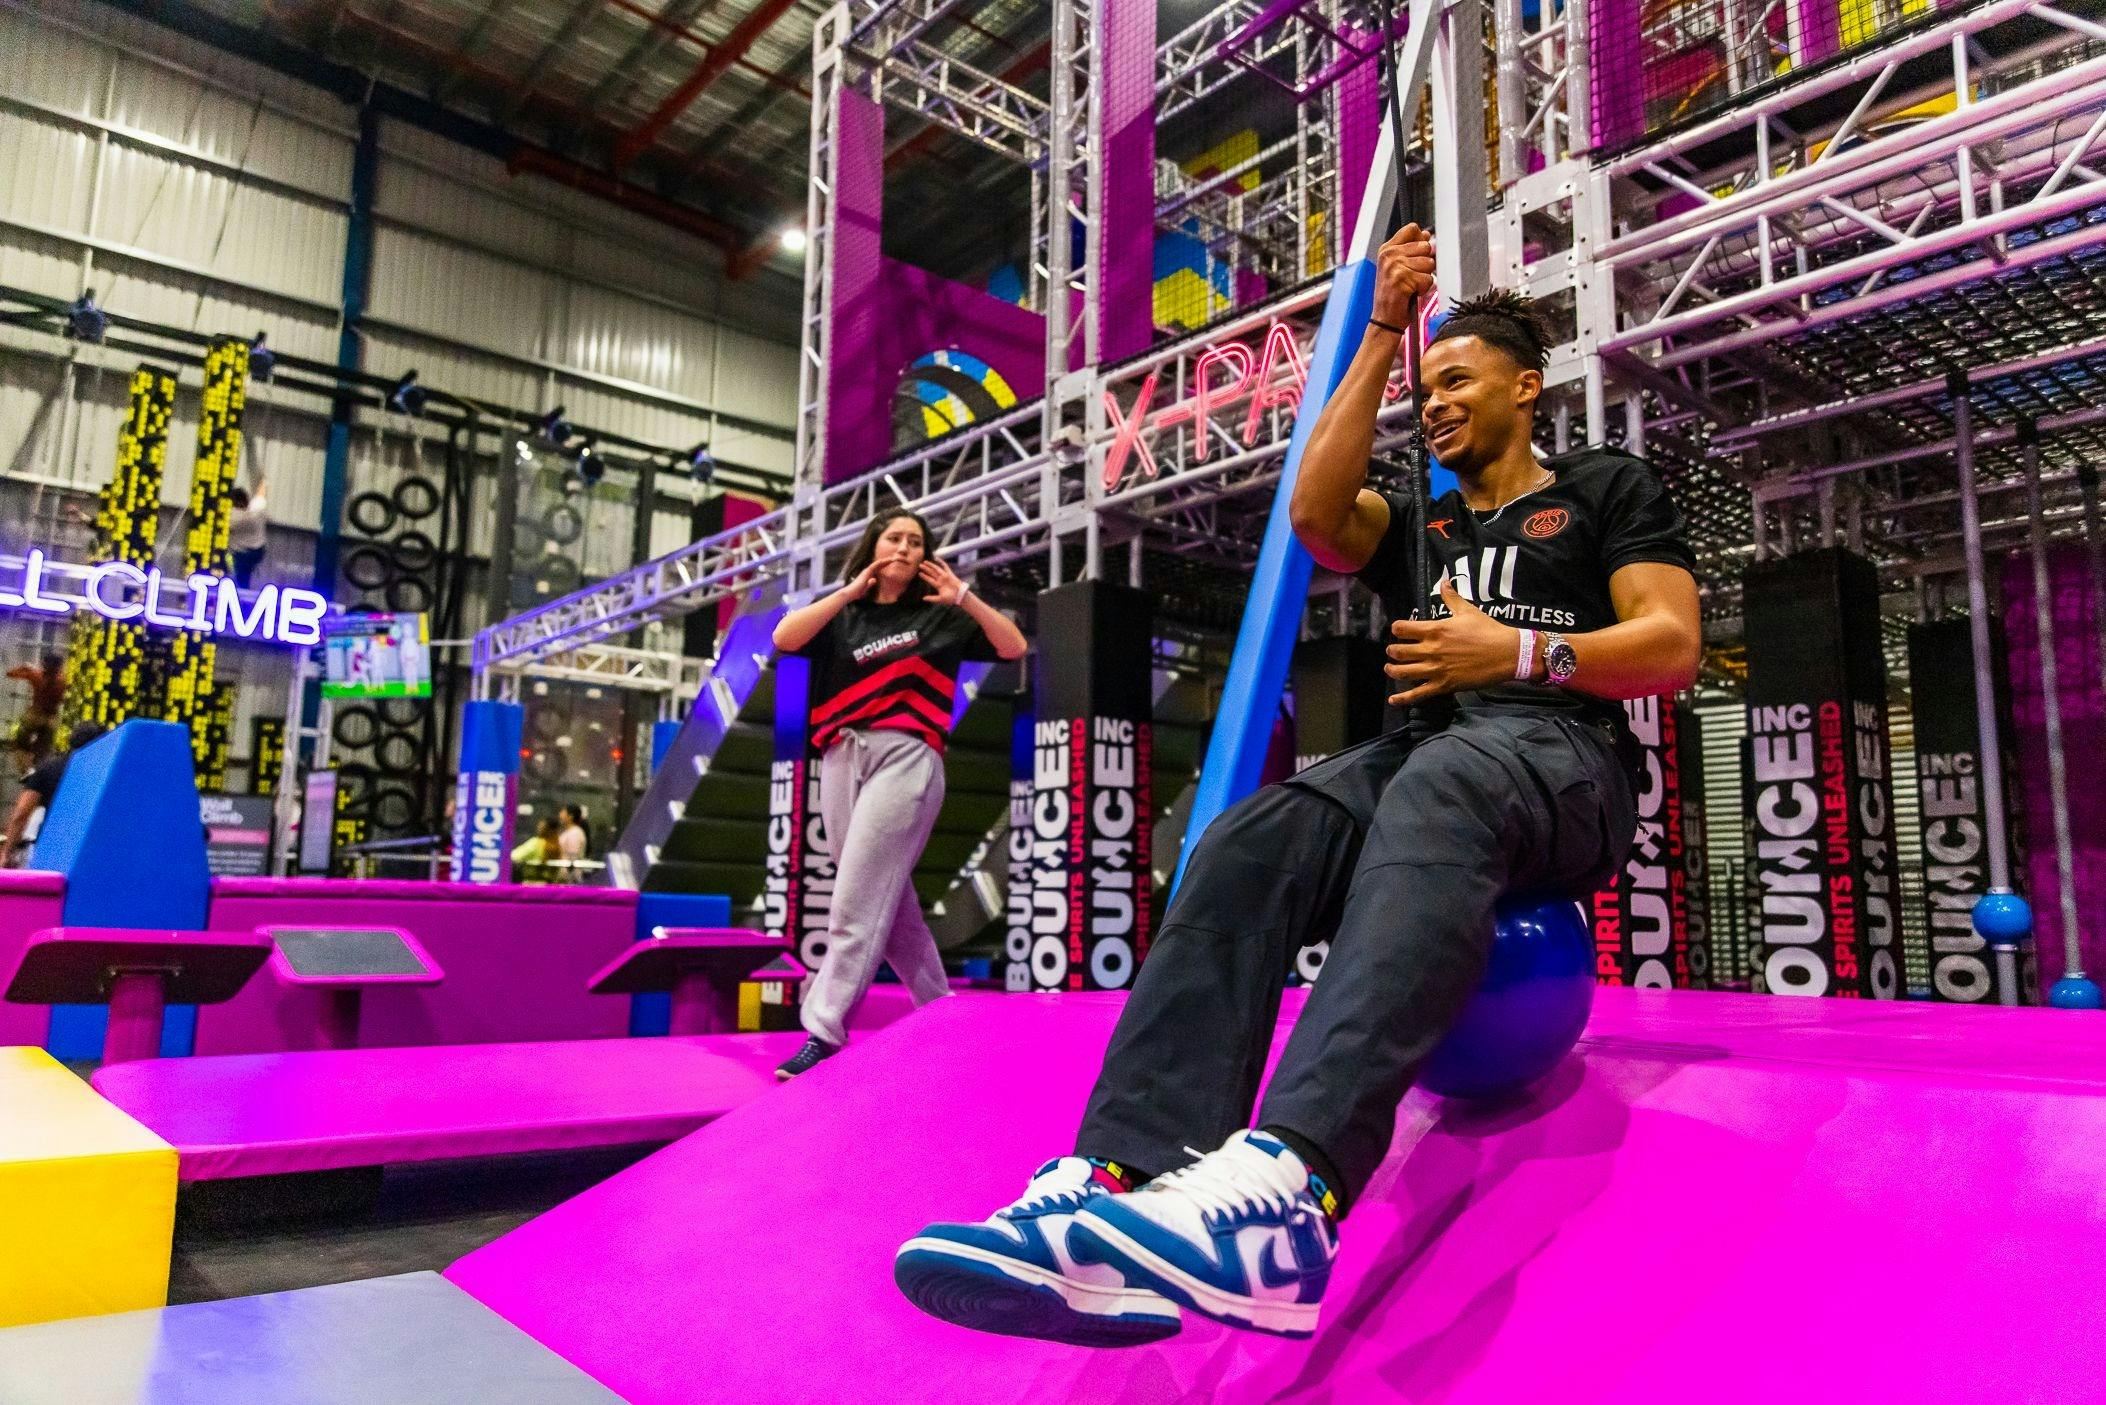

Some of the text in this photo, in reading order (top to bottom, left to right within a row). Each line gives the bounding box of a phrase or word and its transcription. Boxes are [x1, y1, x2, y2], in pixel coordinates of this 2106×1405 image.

[86, 561, 327, 645] CLIMB
[1035, 719, 1070, 746] INC
[1095, 716, 1134, 743] INC
[1752, 703, 1811, 732] INC
[1921, 752, 1974, 774] INC
[1069, 718, 1085, 863] UNLEASHED
[1819, 701, 1849, 865] UNLEASHED
[1005, 797, 1034, 992] BOUNCE
[1032, 745, 1070, 993] OUNCE
[1069, 872, 1085, 963] SPIRITS
[1830, 874, 1858, 979] SPIRITS
